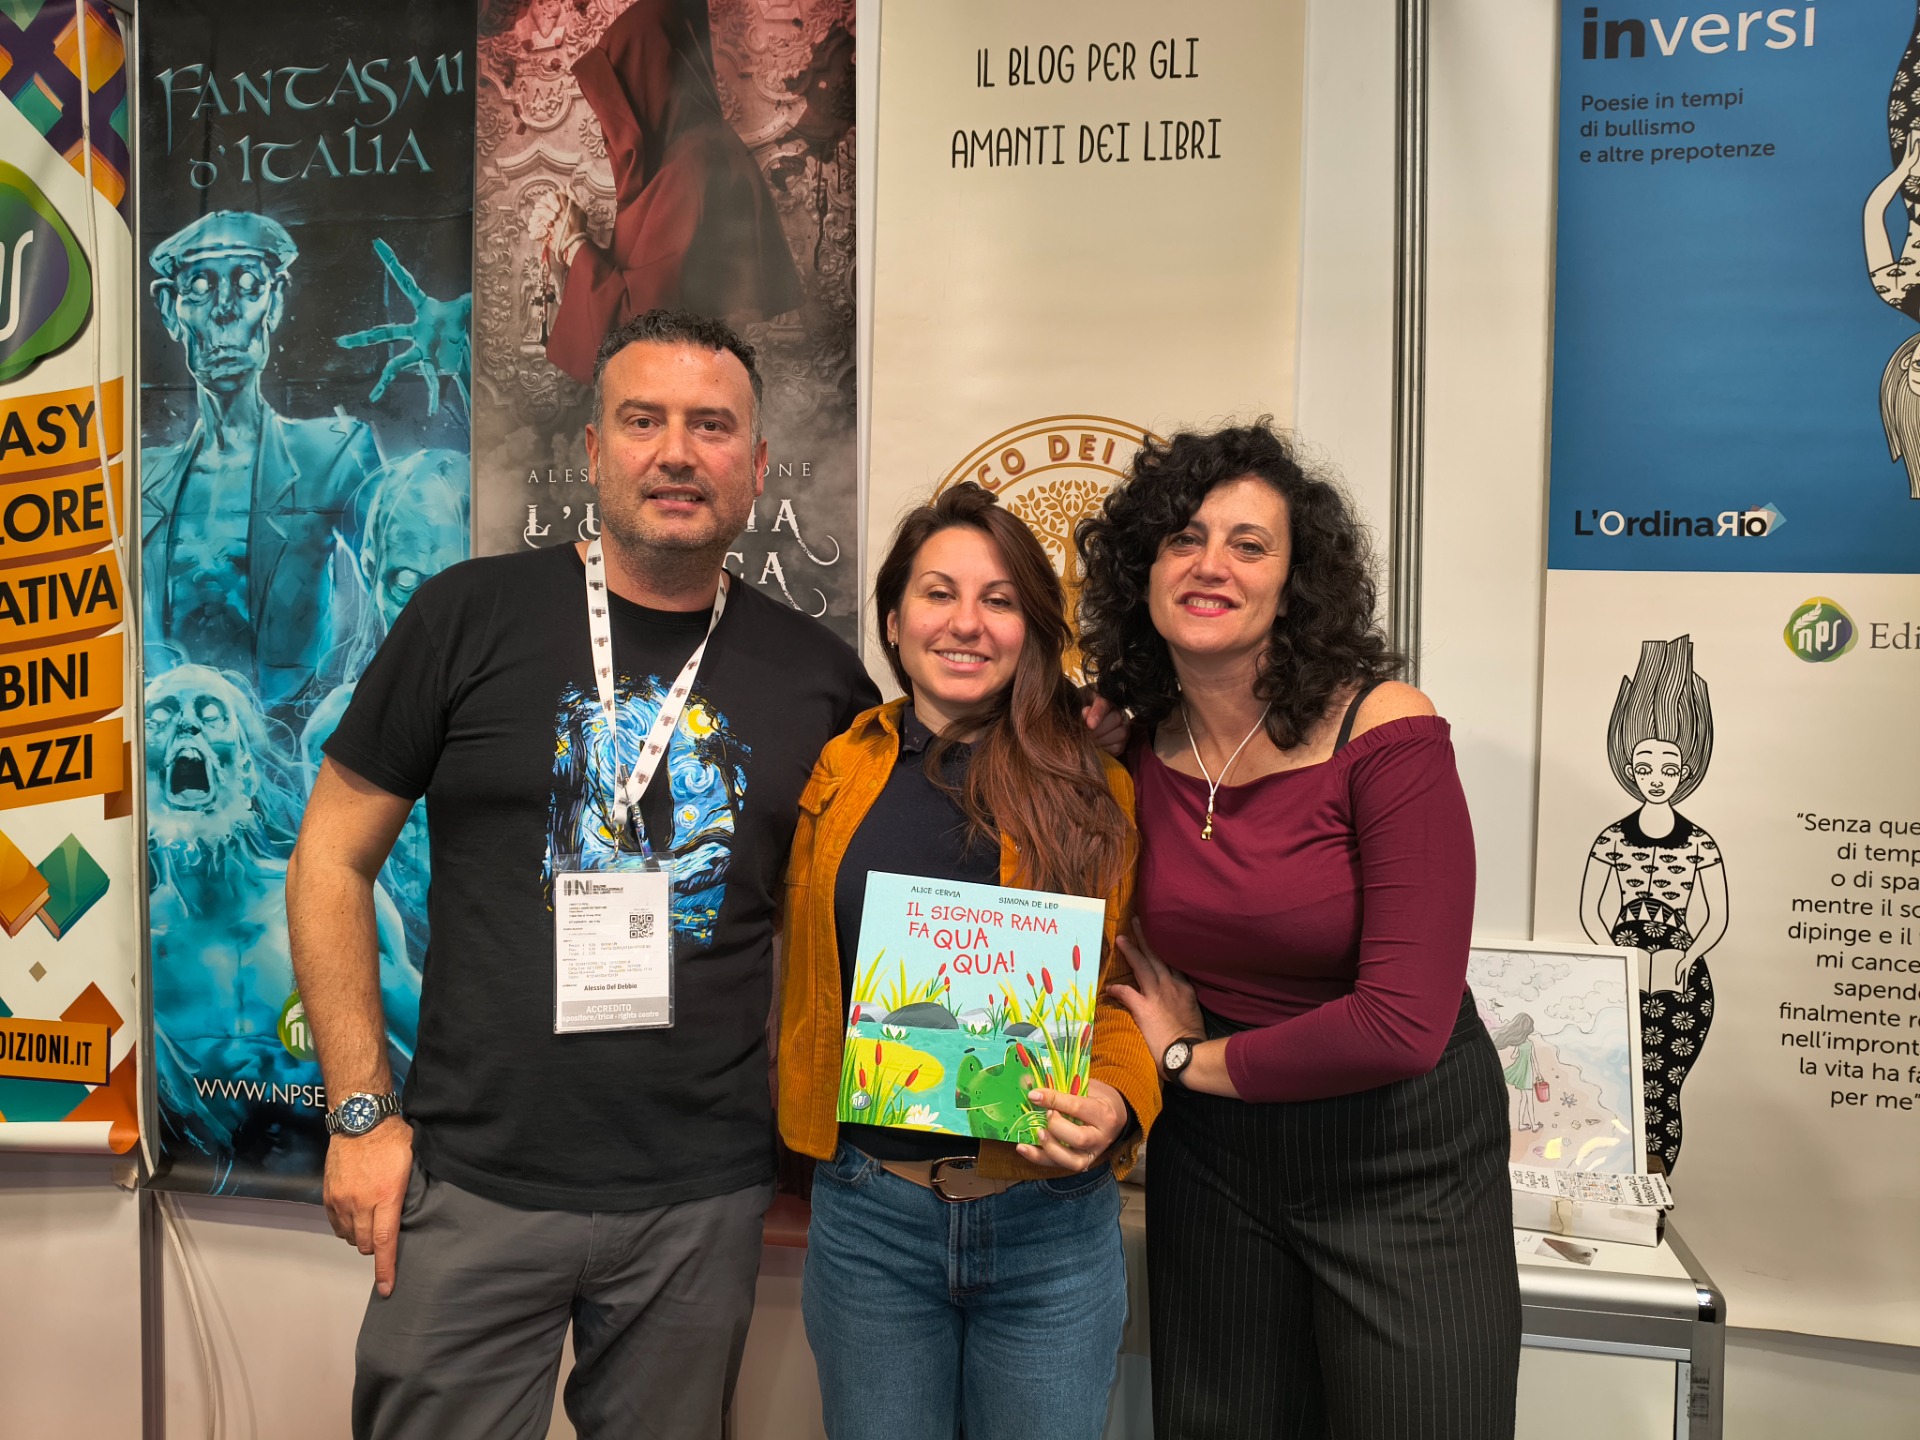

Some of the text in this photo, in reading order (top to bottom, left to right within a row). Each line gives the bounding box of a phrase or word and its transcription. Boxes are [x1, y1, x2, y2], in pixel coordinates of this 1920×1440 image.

[1582, 0, 1816, 61] inversi
[977, 37, 1199, 88] IL BLOG PER GLI
[155, 50, 466, 156] FANTASMI
[1581, 87, 1744, 112] Poesie in tempi
[1580, 118, 1696, 137] di bullismo
[952, 118, 1222, 169] AMANTI DEI LIBRI
[1579, 142, 1777, 166] e altre prepotenze
[1046, 433, 1116, 465] DEI
[0, 482, 104, 546] ORE
[1868, 621, 1920, 650] Edi
[0, 651, 88, 713] BINI
[0, 733, 93, 791] AZZI
[1796, 812, 1920, 839] "Senza que
[1837, 842, 1857, 861] di
[1831, 870, 1920, 894] o di spa
[911, 885, 1059, 910] ALICE CERVIA SIMONA DE LEO
[1791, 897, 1874, 916] mentre
[1881, 898, 1893, 917] il
[906, 901, 1059, 934] IL SIGNOR RANA
[908, 921, 989, 950] FA QUA
[1787, 921, 1912, 947] dipinge e il
[953, 949, 1015, 975] QUA!
[1816, 951, 1920, 974] mi cance
[1833, 981, 1920, 1002] sapend
[586, 1003, 632, 1014] ACCREDITO
[618, 1010, 638, 1021] rights
[1779, 1001, 1901, 1028] finalmente
[1781, 1030, 1920, 1056] nell'impront
[1799, 1057, 1817, 1076] la
[1824, 1060, 1864, 1080] vita
[1872, 1062, 1899, 1082] ha
[193, 1077, 326, 1108] WWW.NPSE
[1830, 1089, 1869, 1109] per
